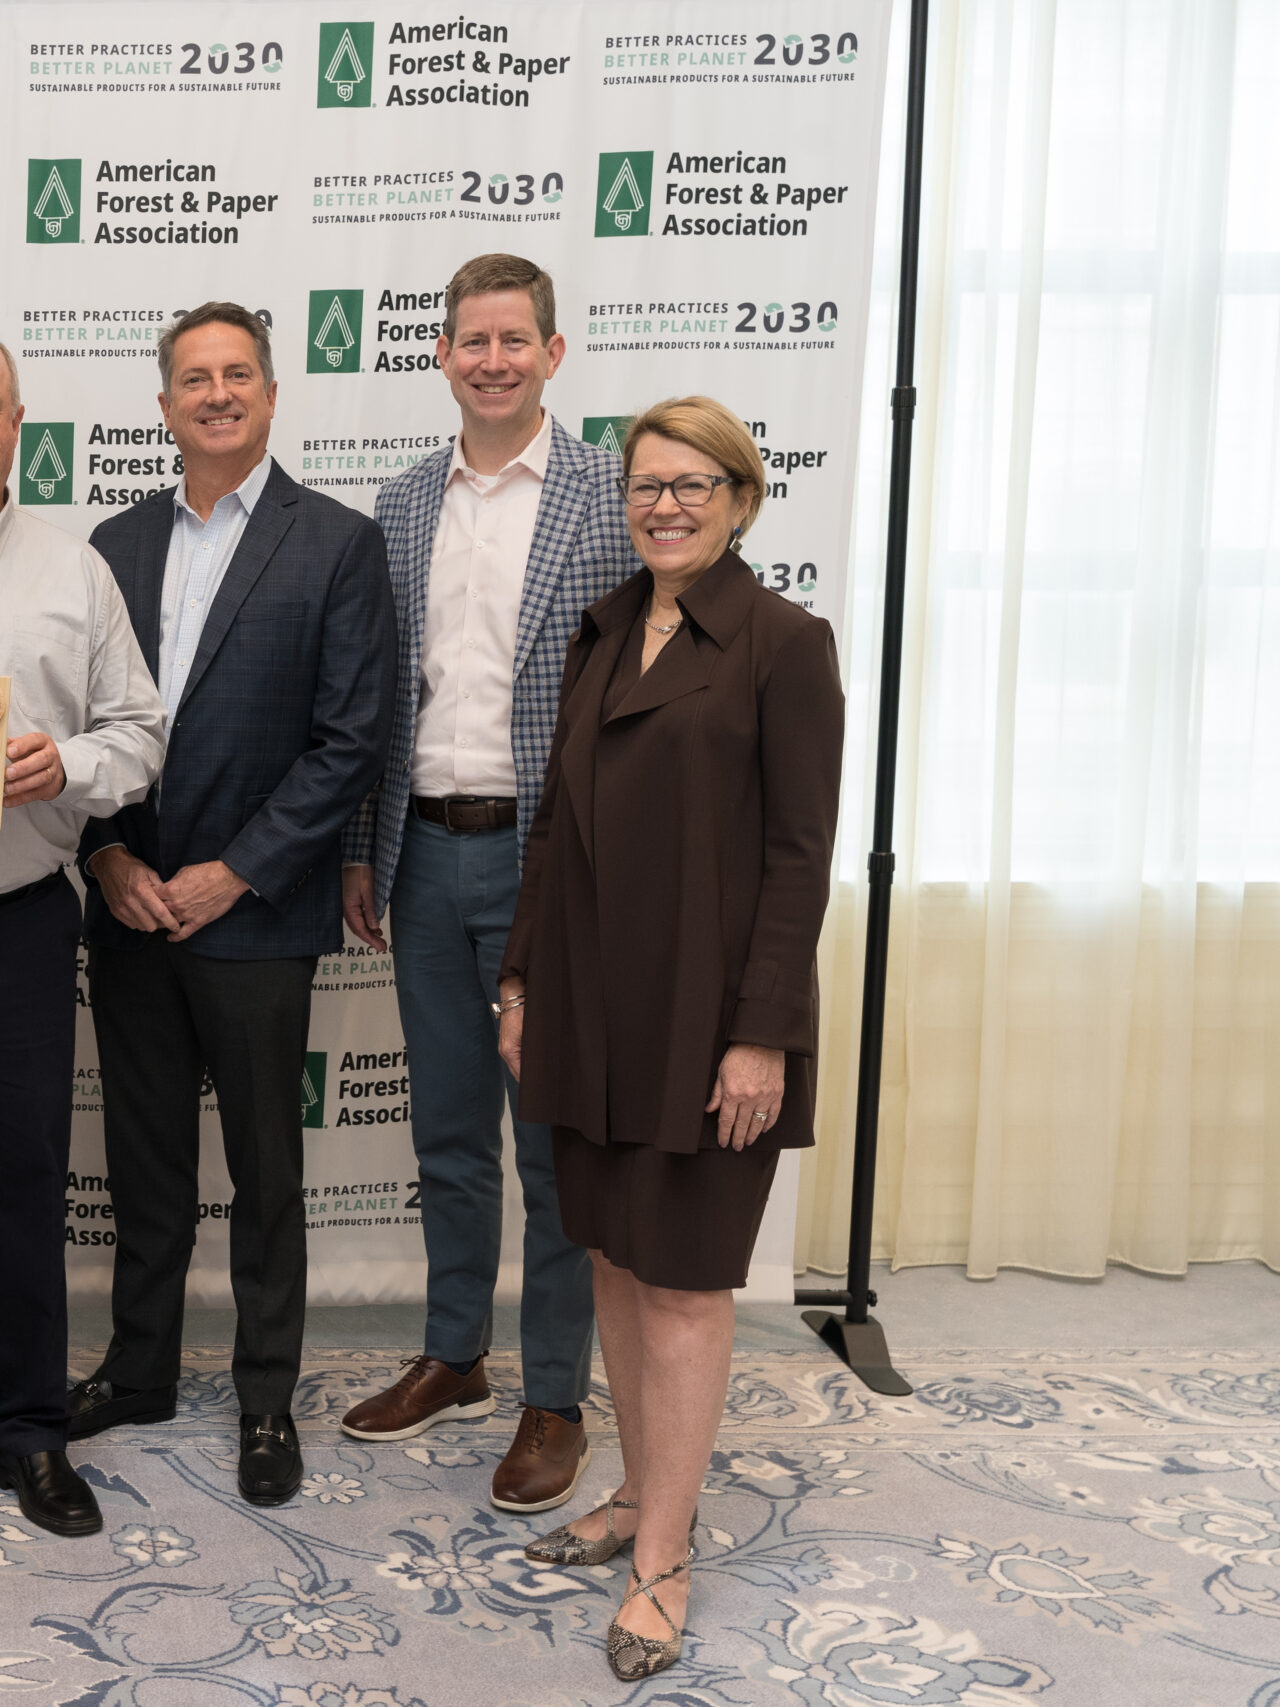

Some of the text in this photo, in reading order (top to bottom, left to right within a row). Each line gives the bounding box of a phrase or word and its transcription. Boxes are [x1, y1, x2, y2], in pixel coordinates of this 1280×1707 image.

[388, 21, 508, 44] American
[606, 34, 747, 48] BETTER PRACTICES
[31, 44, 172, 55] BETTER PRACTICES
[753, 32, 859, 67] 2030
[179, 41, 284, 75] 2030
[604, 52, 747, 68] BETTER PLANET
[30, 61, 173, 75] BETTER PLANET
[389, 50, 571, 83] Forest & Paper
[29, 82, 281, 92] SUSTAINABLE PRODUCTS FOR A SUSTAINABLE FUTURE
[603, 73, 855, 85] SUSTAINABLE PRODUCTS FOR A SUSTAINABLE FUTURE
[386, 78, 529, 107] Association
[666, 150, 786, 174] American
[96, 159, 216, 182] American
[314, 171, 454, 187] BETTER PRACTICES
[460, 170, 564, 206] 2030
[313, 188, 454, 207] BETTER PLANET
[665, 183, 848, 211] Forest & Paper
[97, 191, 278, 220] Forest & Paper
[312, 209, 560, 224] SUSTAINABLE PRODUCTS FOR A SUSTAINABLE FUTURE
[662, 212, 807, 236] Association
[94, 220, 238, 244] Association
[24, 310, 76, 322] BETTER
[83, 310, 163, 321] PRACTICES
[589, 302, 728, 316] BETTER PRACTICES
[734, 301, 838, 334] 2030
[23, 327, 88, 341] BETTER
[588, 319, 728, 335] BETTER PLANET
[22, 349, 157, 358] SUSTAINABLE PRODUCTS FOR
[587, 341, 835, 352] SUSTAINABLE PRODUCTS FOR A SUSTAINABLE FUTURE
[303, 436, 440, 451] BETTER PRACTICES
[89, 453, 165, 475] Forest
[302, 455, 367, 470] BETTER
[761, 447, 827, 475] Paper
[301, 477, 364, 486] SUSTAINABLE
[343, 979, 386, 991] PRODUCTS
[339, 1076, 409, 1100] Forest
[324, 1182, 398, 1197] PRACTICES
[334, 1197, 398, 1212] PLANET
[327, 1218, 372, 1228] PRODUCTS
[375, 1216, 392, 1225] FOR
